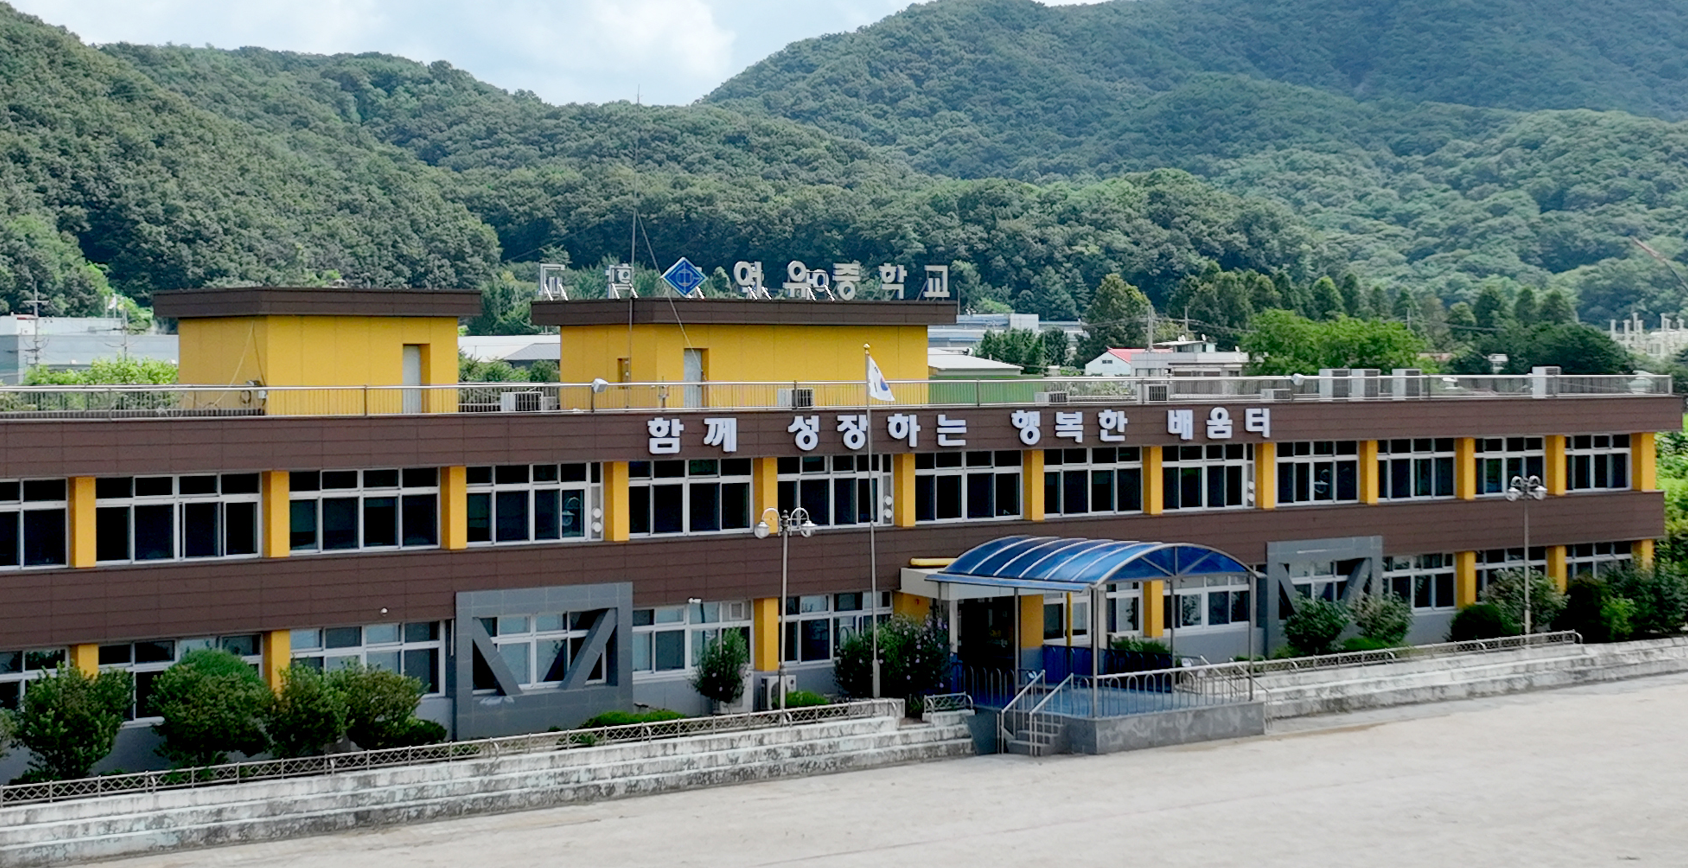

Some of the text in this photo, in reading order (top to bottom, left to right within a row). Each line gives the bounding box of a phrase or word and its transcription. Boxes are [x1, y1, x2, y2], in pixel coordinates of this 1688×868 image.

[647, 406, 1271, 455] 함께 성장하는 행복한 배움터
